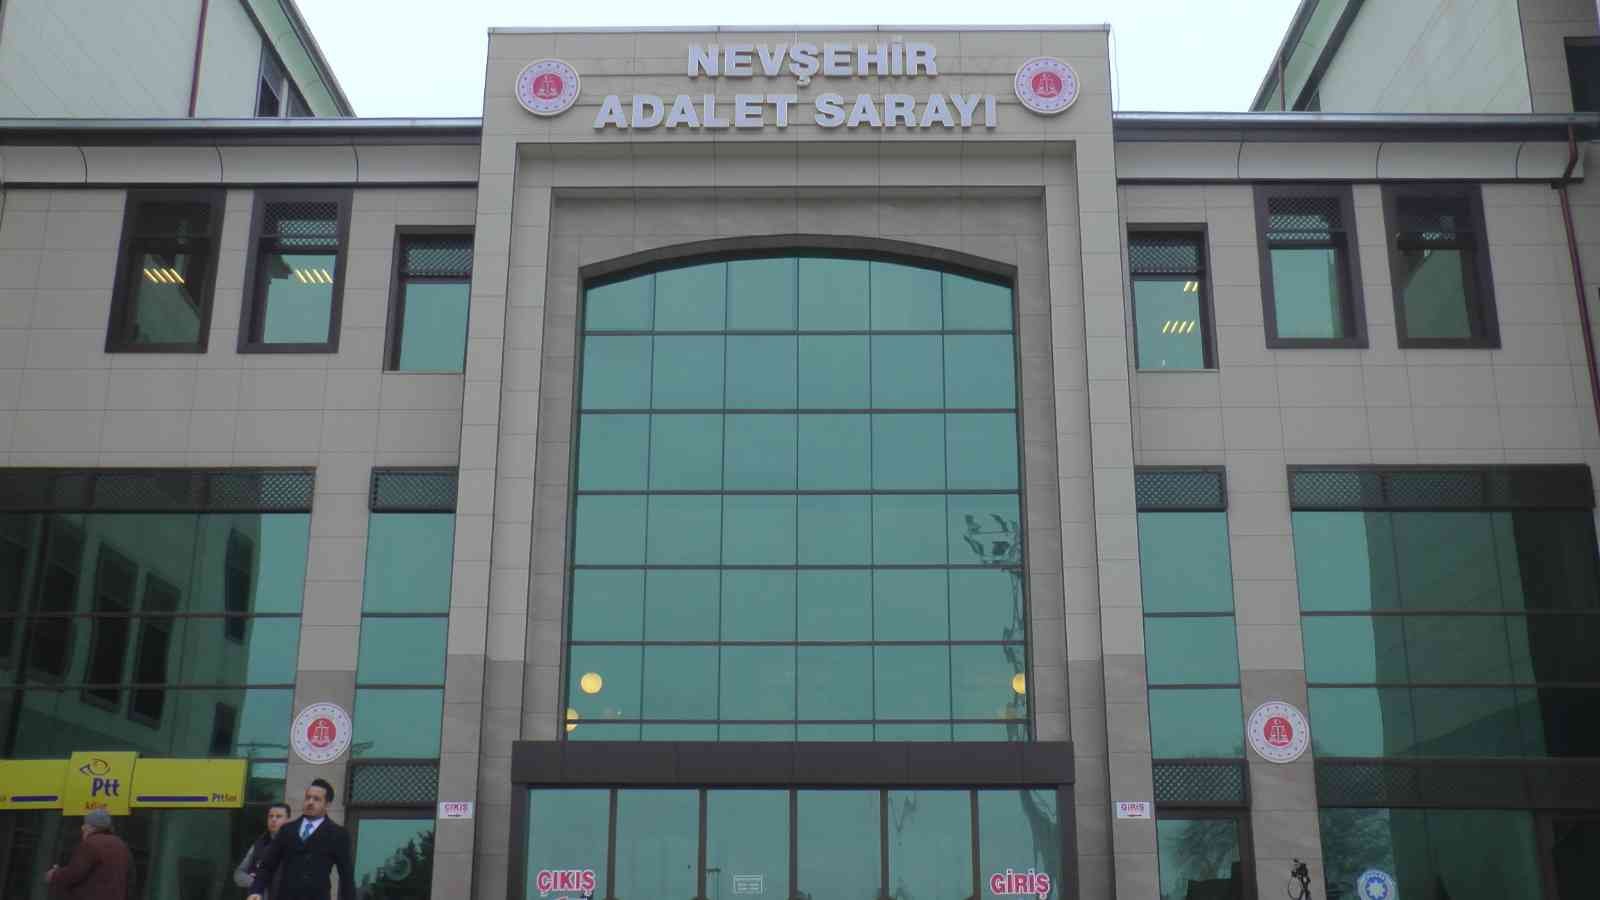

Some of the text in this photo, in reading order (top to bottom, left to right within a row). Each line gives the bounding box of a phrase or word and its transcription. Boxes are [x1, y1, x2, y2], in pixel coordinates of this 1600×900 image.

[687, 36, 938, 87] NEVŞEHİR
[592, 92, 997, 129] ADALET SARAYI
[91, 777, 120, 797] Ptt
[537, 869, 596, 896] ÇIKIŞ
[990, 868, 1051, 899] GİRİŞ
